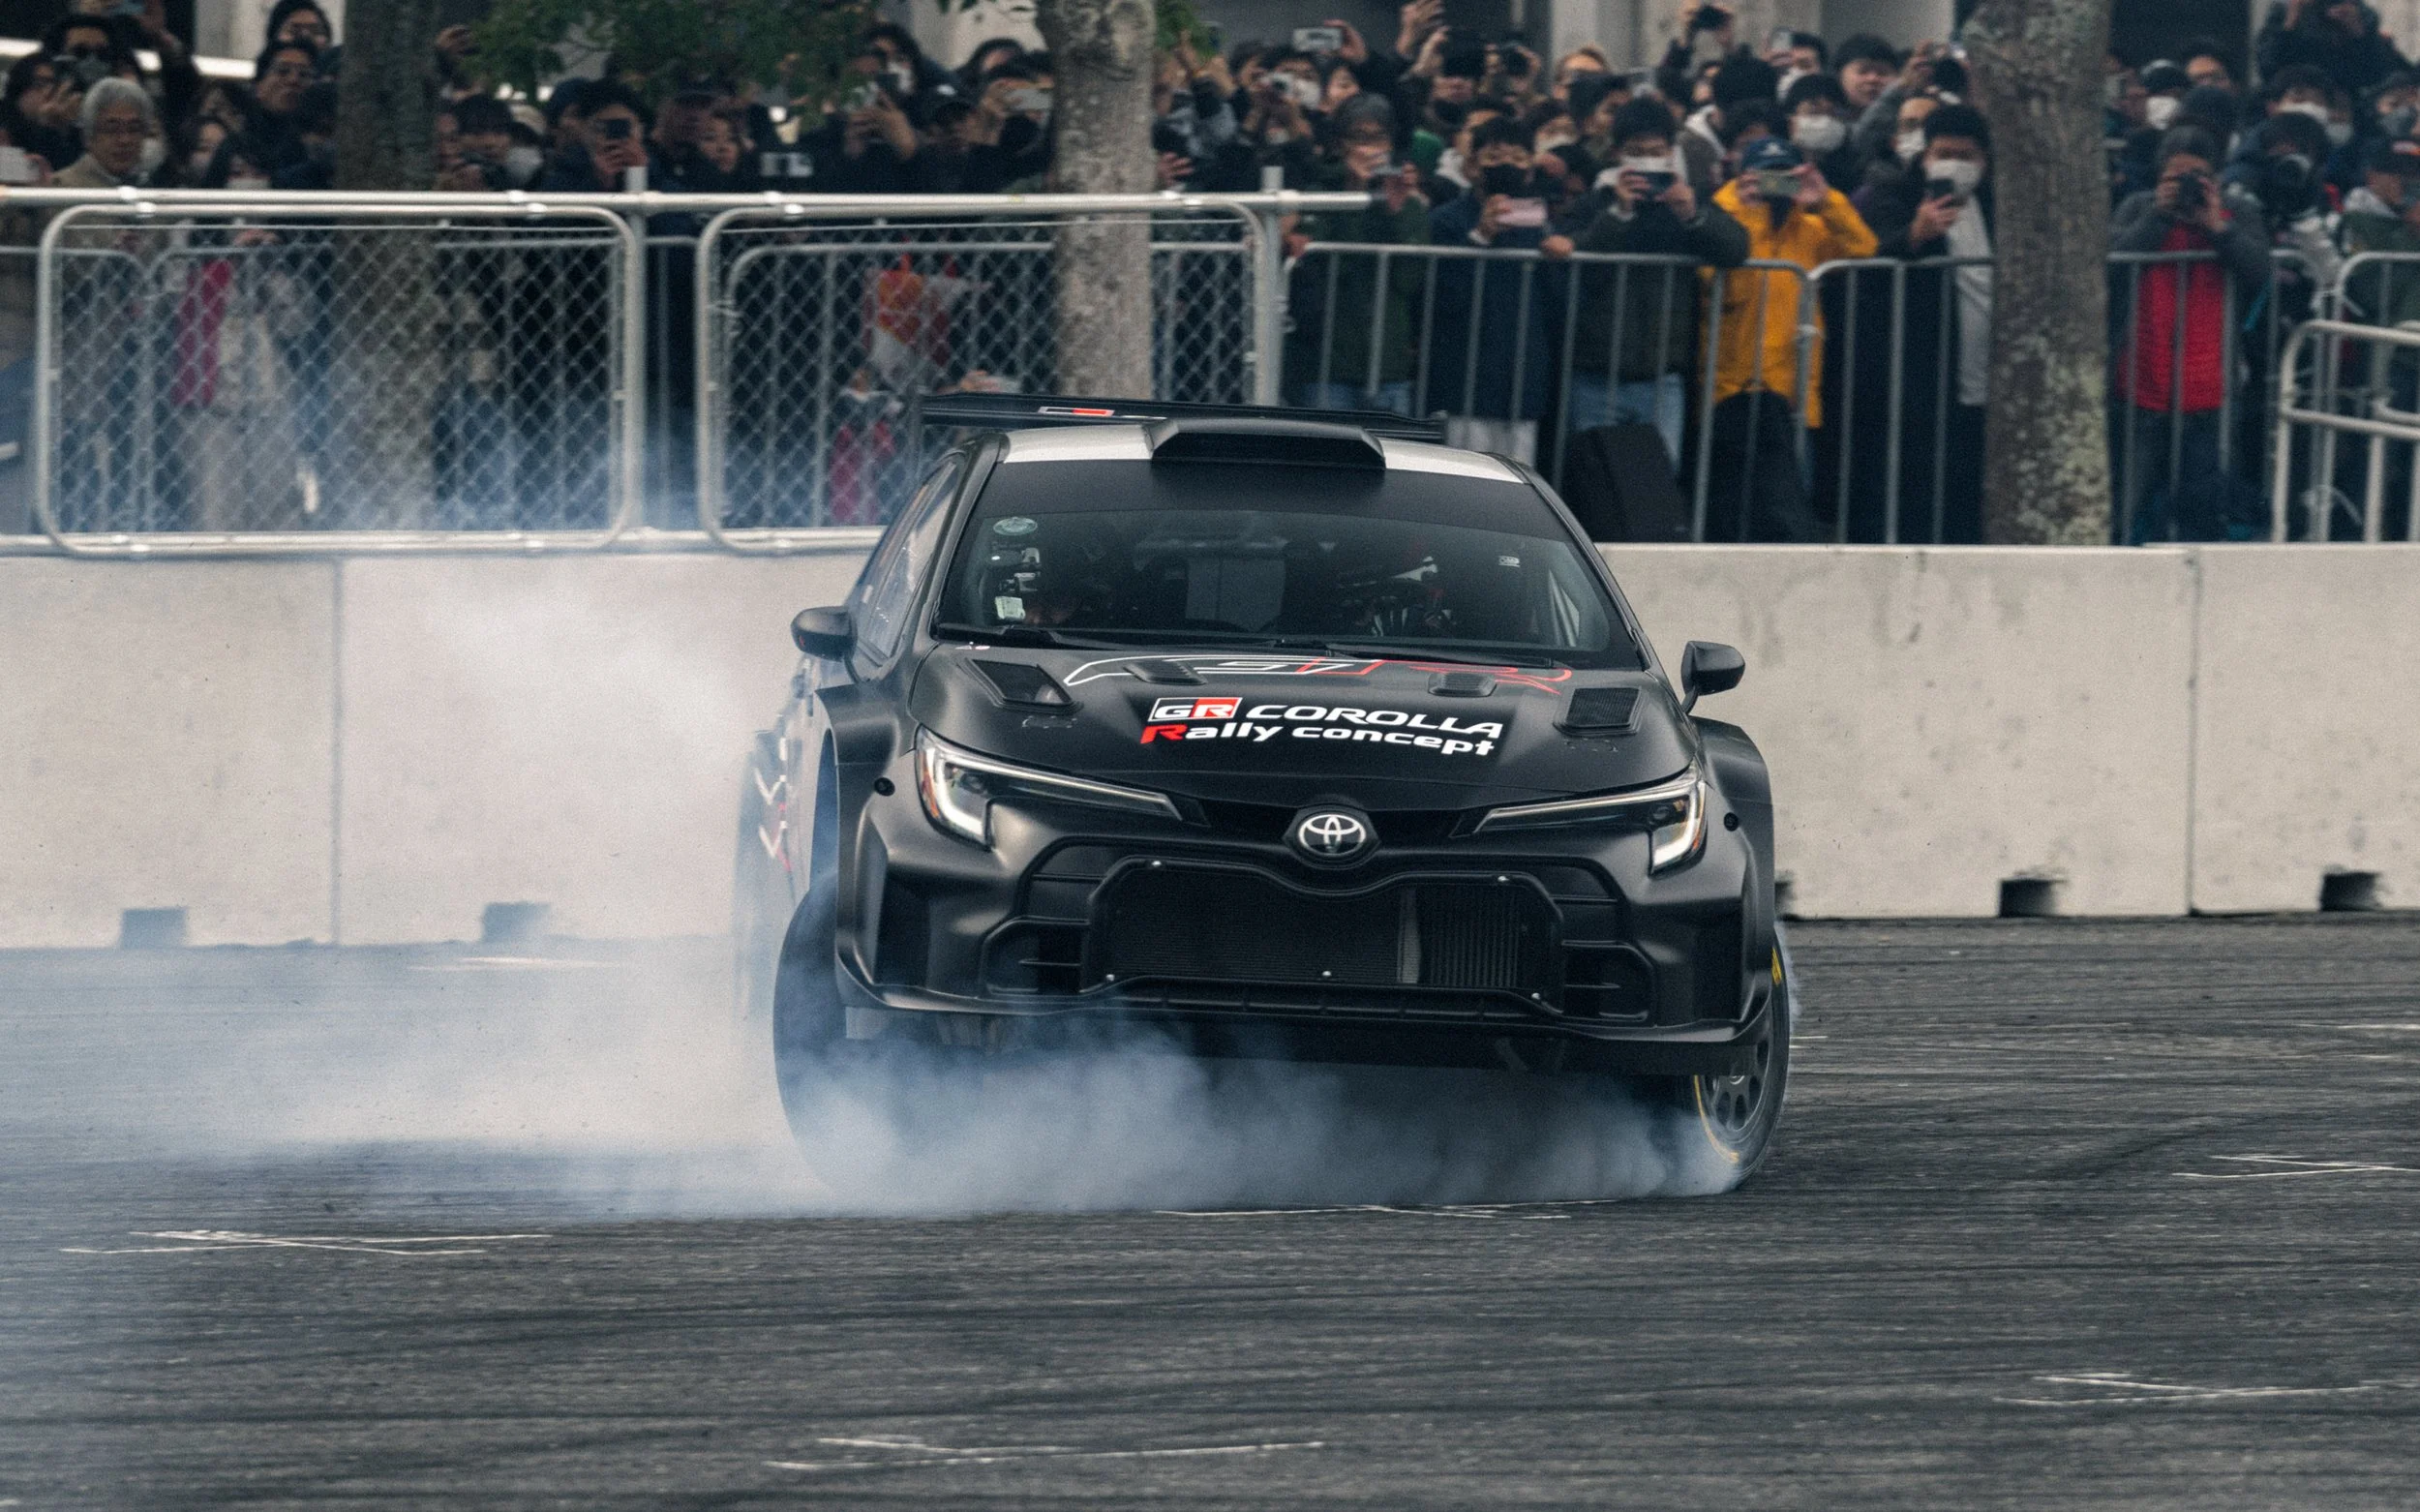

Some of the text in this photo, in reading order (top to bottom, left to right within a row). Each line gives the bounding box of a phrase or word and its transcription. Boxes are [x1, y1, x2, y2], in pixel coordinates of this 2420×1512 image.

[1153, 704, 1503, 739] GR COROLLA
[1140, 722, 1495, 756] Rally concept
